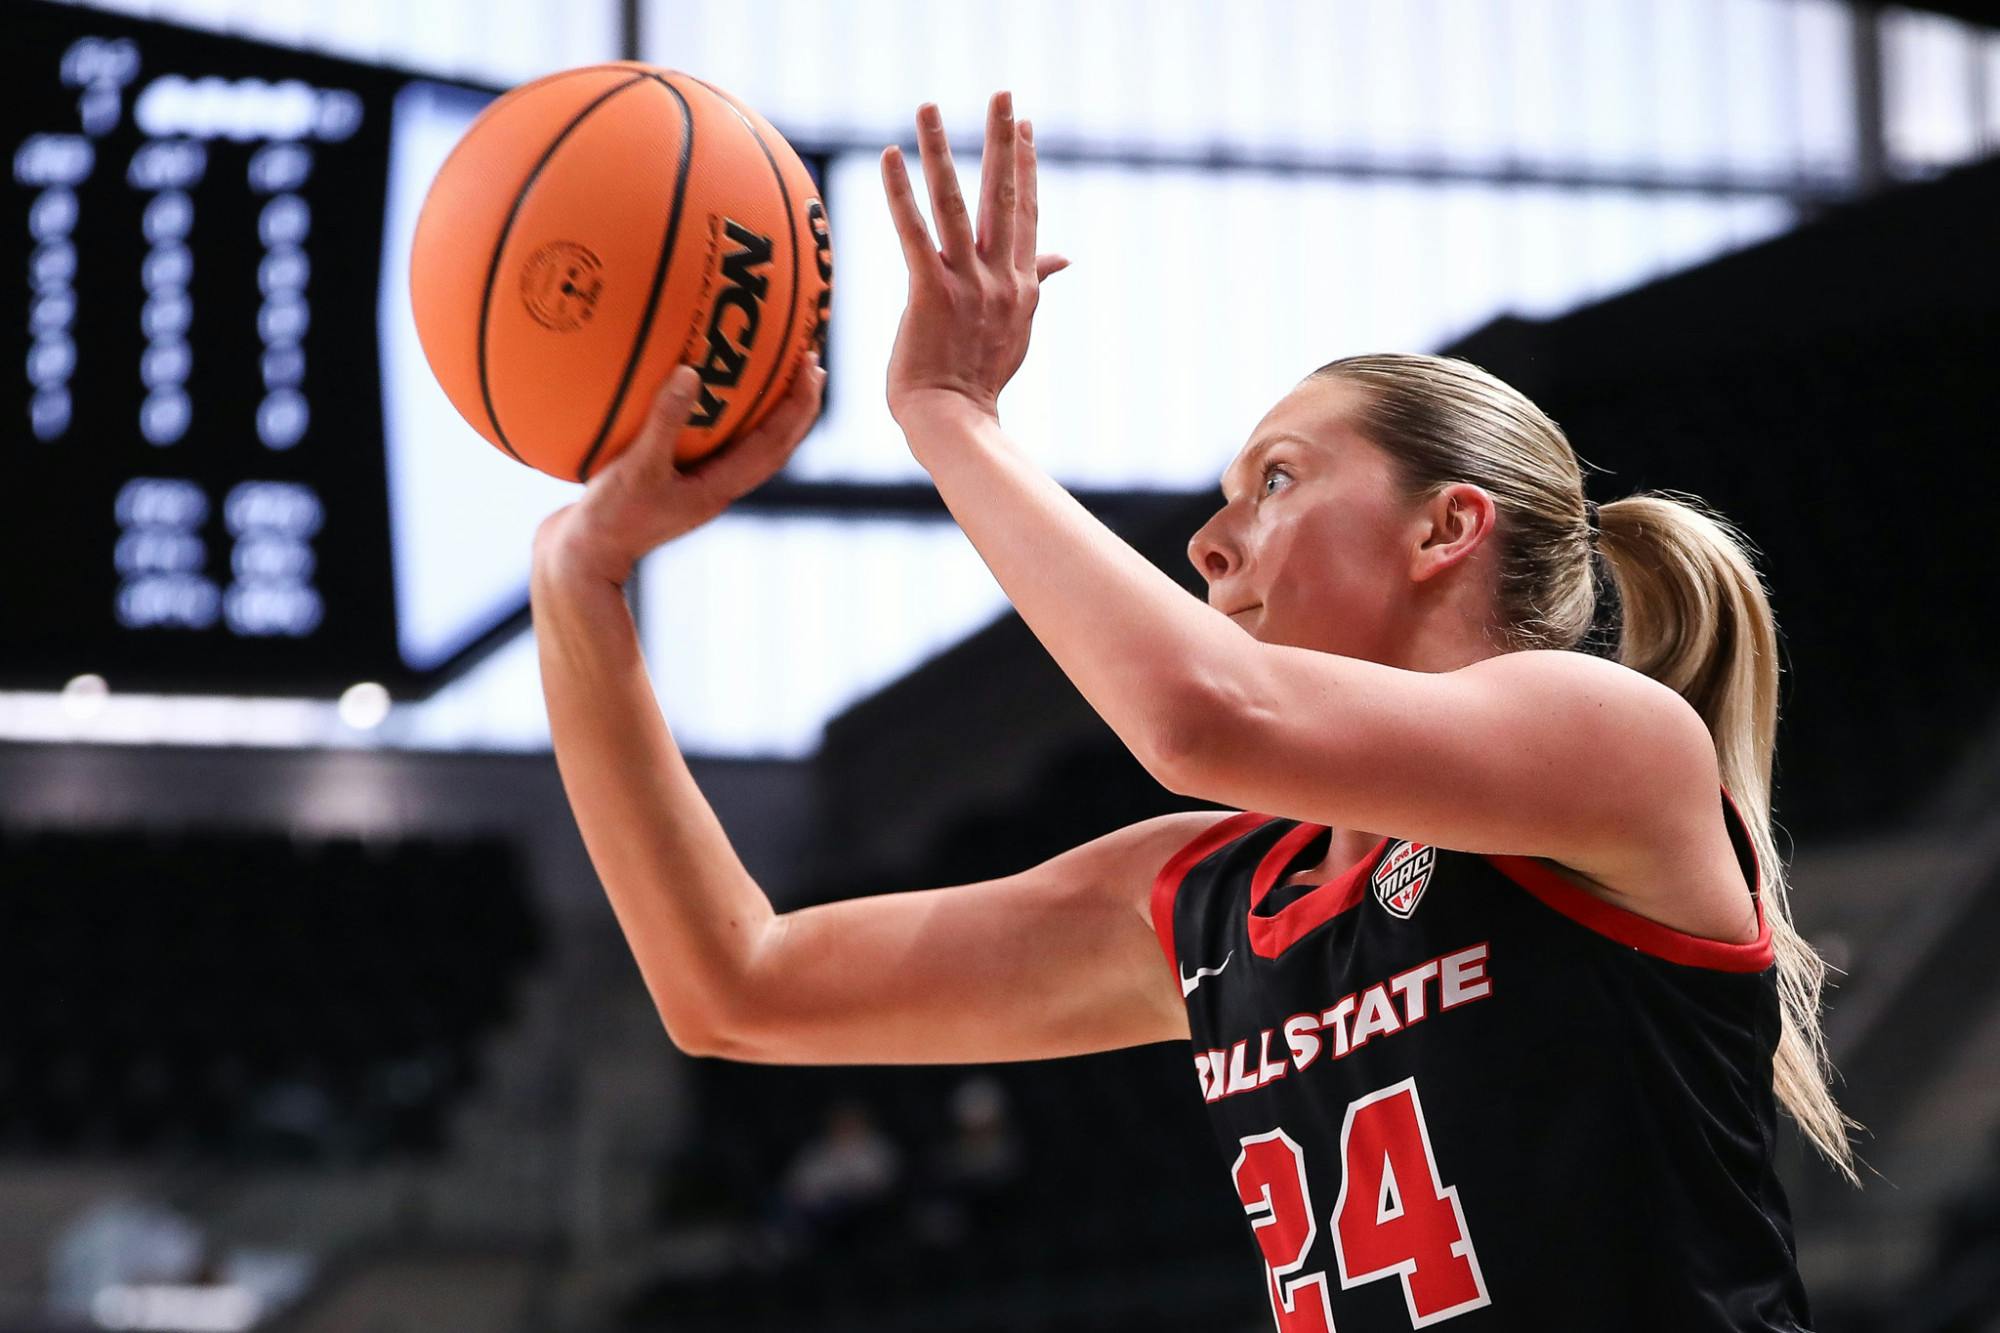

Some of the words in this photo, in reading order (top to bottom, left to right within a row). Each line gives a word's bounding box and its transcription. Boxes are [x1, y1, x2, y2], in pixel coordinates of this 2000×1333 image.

[686, 216, 775, 428] NCAA
[1379, 849, 1431, 900] MAC
[1283, 941, 1493, 1073] STATE
[1231, 1076, 1492, 1333] 24
